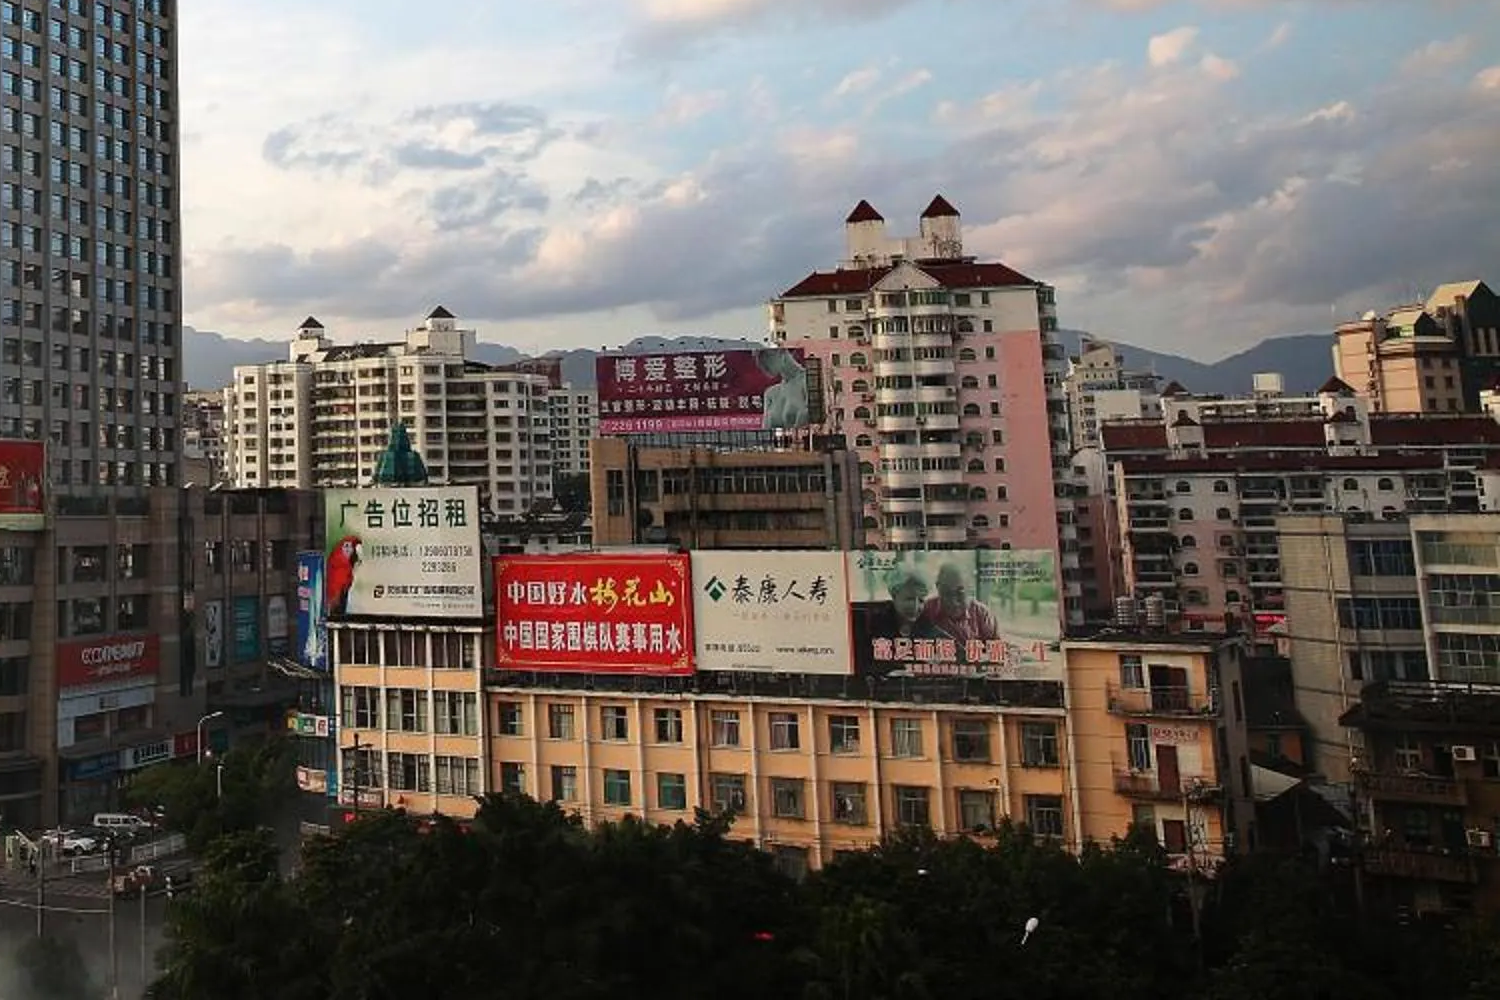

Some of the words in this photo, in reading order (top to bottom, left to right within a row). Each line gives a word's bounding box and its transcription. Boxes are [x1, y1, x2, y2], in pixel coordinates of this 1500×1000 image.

[615, 354, 727, 383] 博爱整形
[339, 498, 468, 530] 广告位招租
[507, 577, 674, 614] 中国好水梅花山
[731, 574, 829, 605] 泰康人寿
[503, 621, 683, 653] 中国国家围棋队赛事用水
